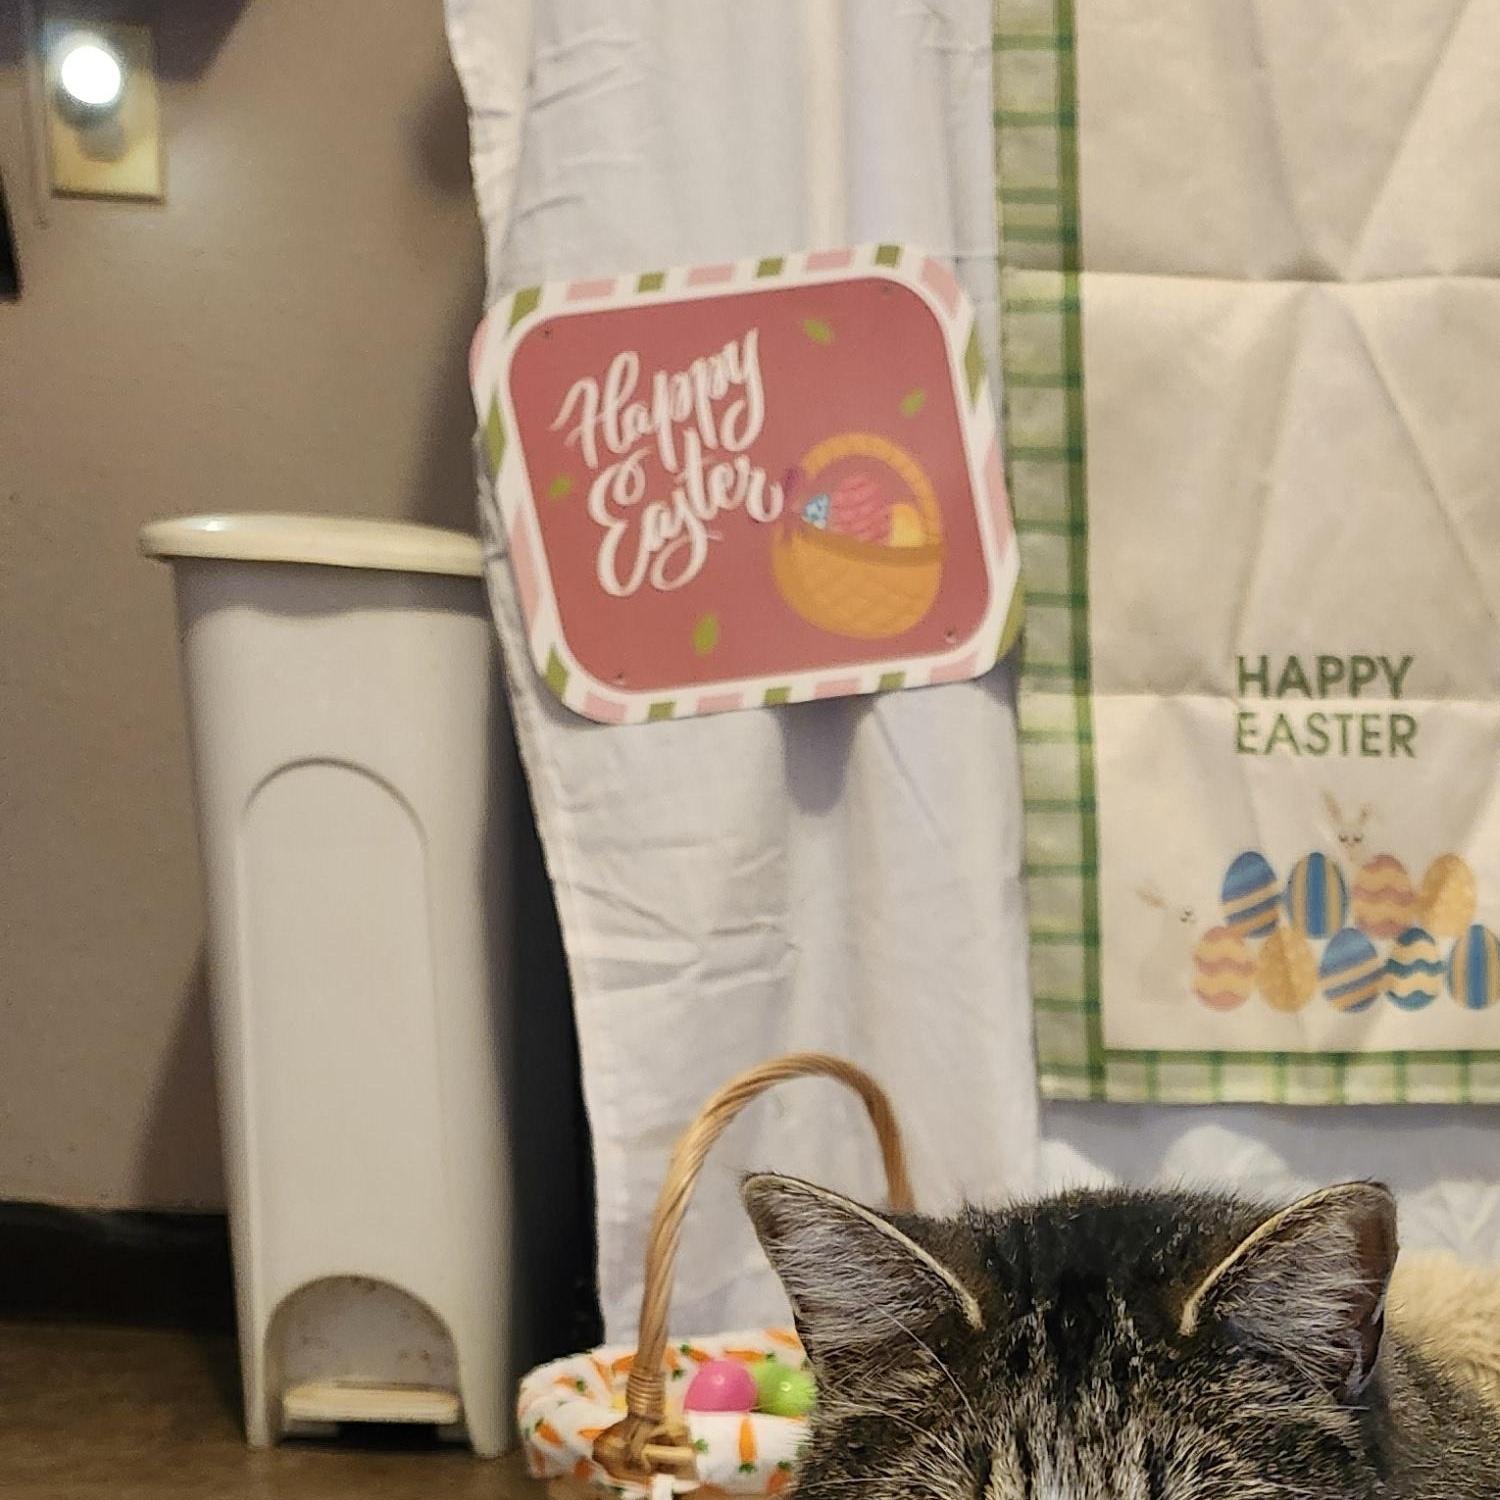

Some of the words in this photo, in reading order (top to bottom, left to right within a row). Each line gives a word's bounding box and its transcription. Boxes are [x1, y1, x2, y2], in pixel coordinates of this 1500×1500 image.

[549, 327, 766, 475] Happy
[587, 425, 785, 597] Easter
[1235, 654, 1414, 699] HAPPY
[1234, 711, 1418, 758] EASTER
